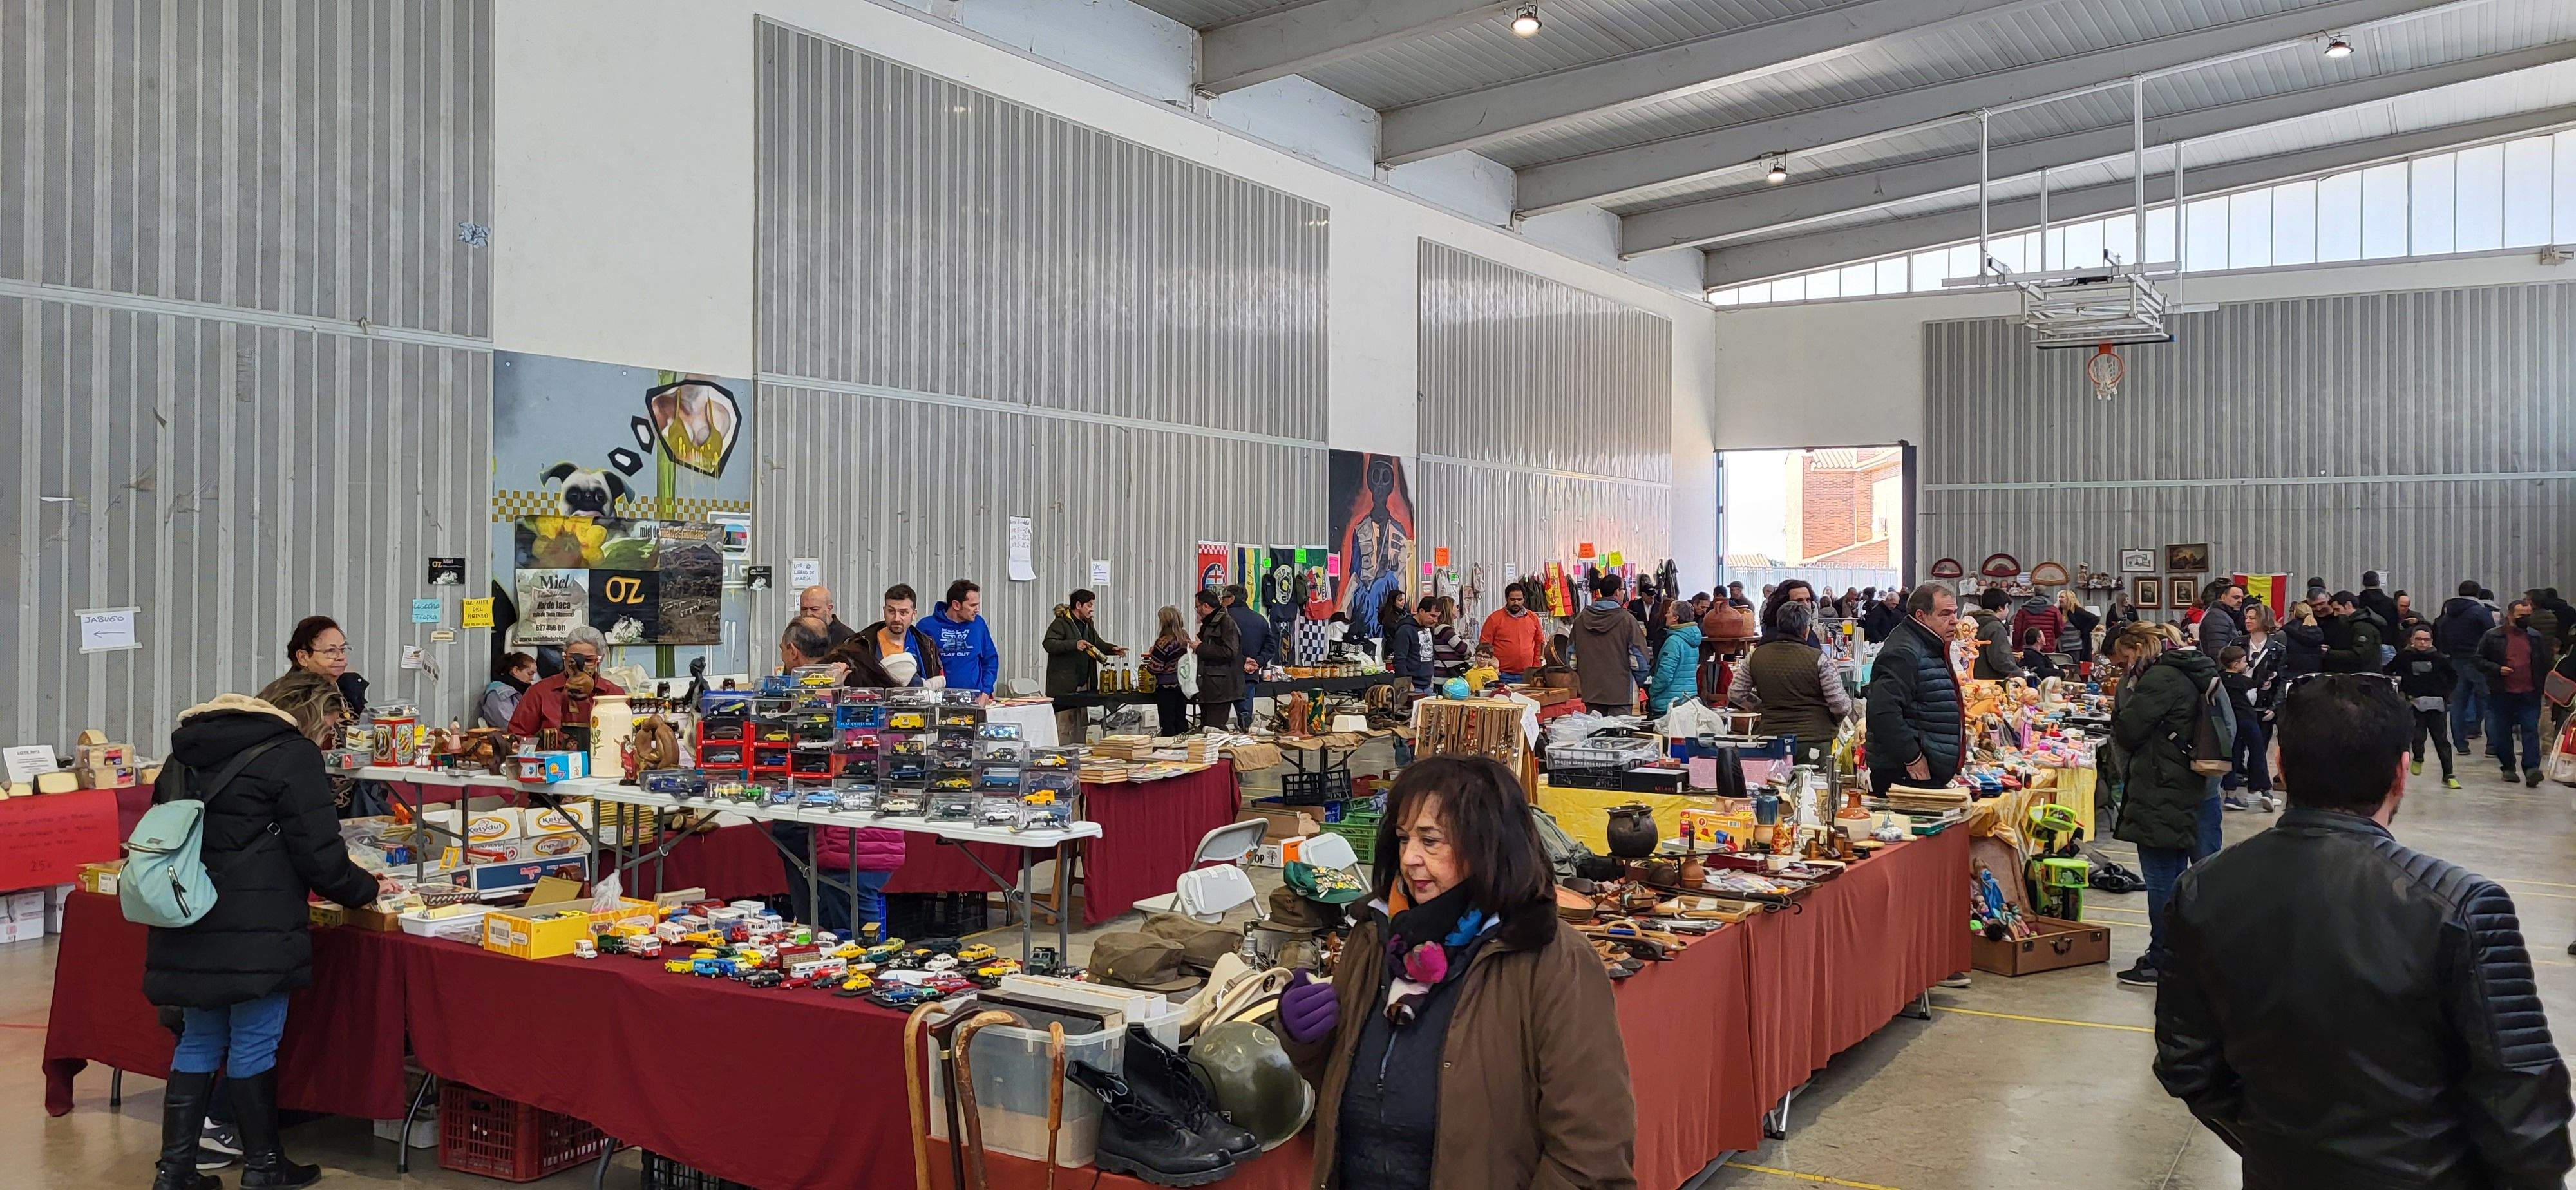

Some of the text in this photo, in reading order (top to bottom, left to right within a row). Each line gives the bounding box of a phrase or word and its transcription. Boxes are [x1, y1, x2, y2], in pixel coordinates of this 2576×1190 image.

[639, 525, 652, 538] miel
[653, 525, 659, 538] de
[540, 574, 570, 589] Miel
[605, 576, 645, 605] OZ
[84, 616, 124, 624] JABUGO
